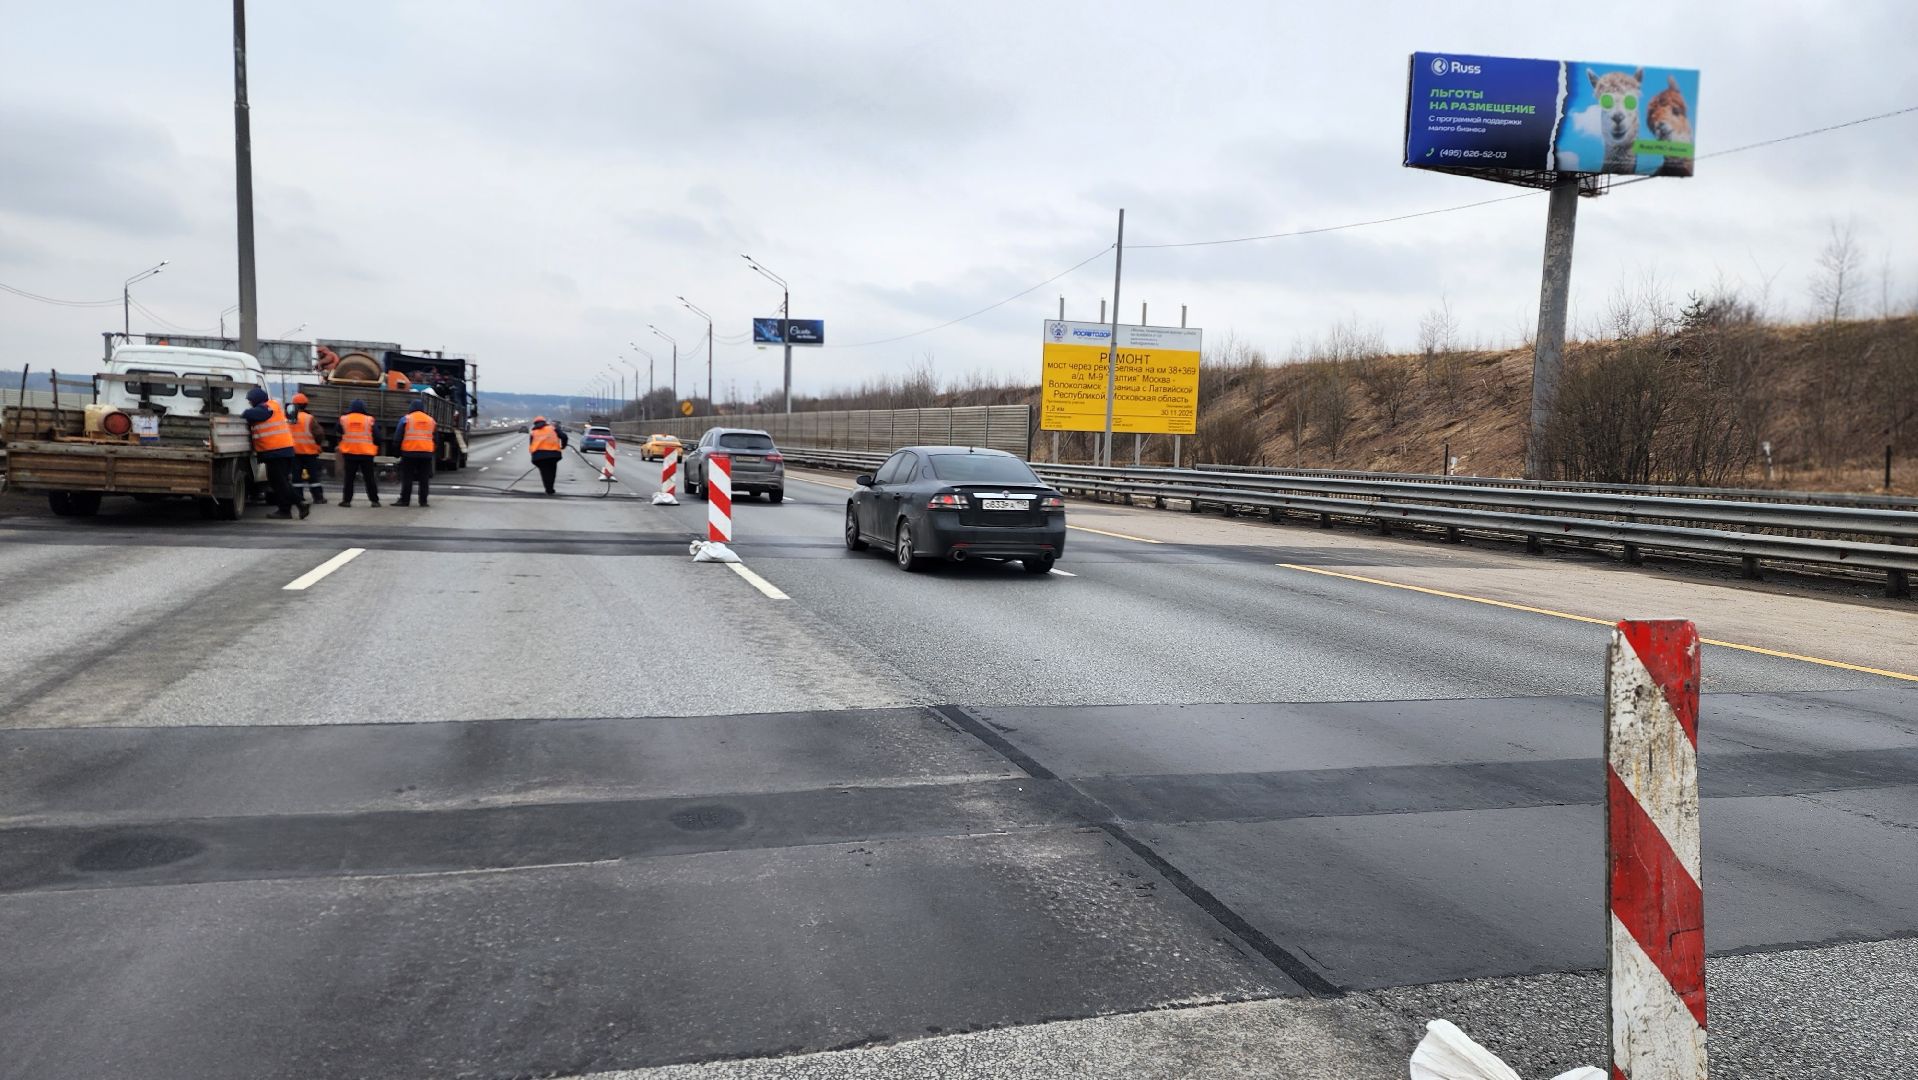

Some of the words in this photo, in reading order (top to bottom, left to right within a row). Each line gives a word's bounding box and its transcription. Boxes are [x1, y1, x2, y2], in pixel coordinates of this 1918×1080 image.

[1451, 61, 1481, 74] Russ
[1430, 88, 1484, 99] ЛЬГОТЫ
[1429, 101, 1448, 110] НА
[1450, 102, 1536, 114] РАЗМЕЩЕНИЕ
[1436, 116, 1481, 124] программой
[1483, 118, 1522, 126] поддержки
[1456, 125, 1486, 133] бизнеса
[1440, 149, 1462, 158] (495)
[1463, 150, 1507, 159] 626-52-03
[1069, 363, 1091, 372] через
[1072, 372, 1084, 380] а/д
[1143, 375, 1170, 384] Москва
[1048, 380, 1102, 390] Волоколамск
[1149, 384, 1193, 394] Латвийской
[1158, 394, 1189, 403] область
